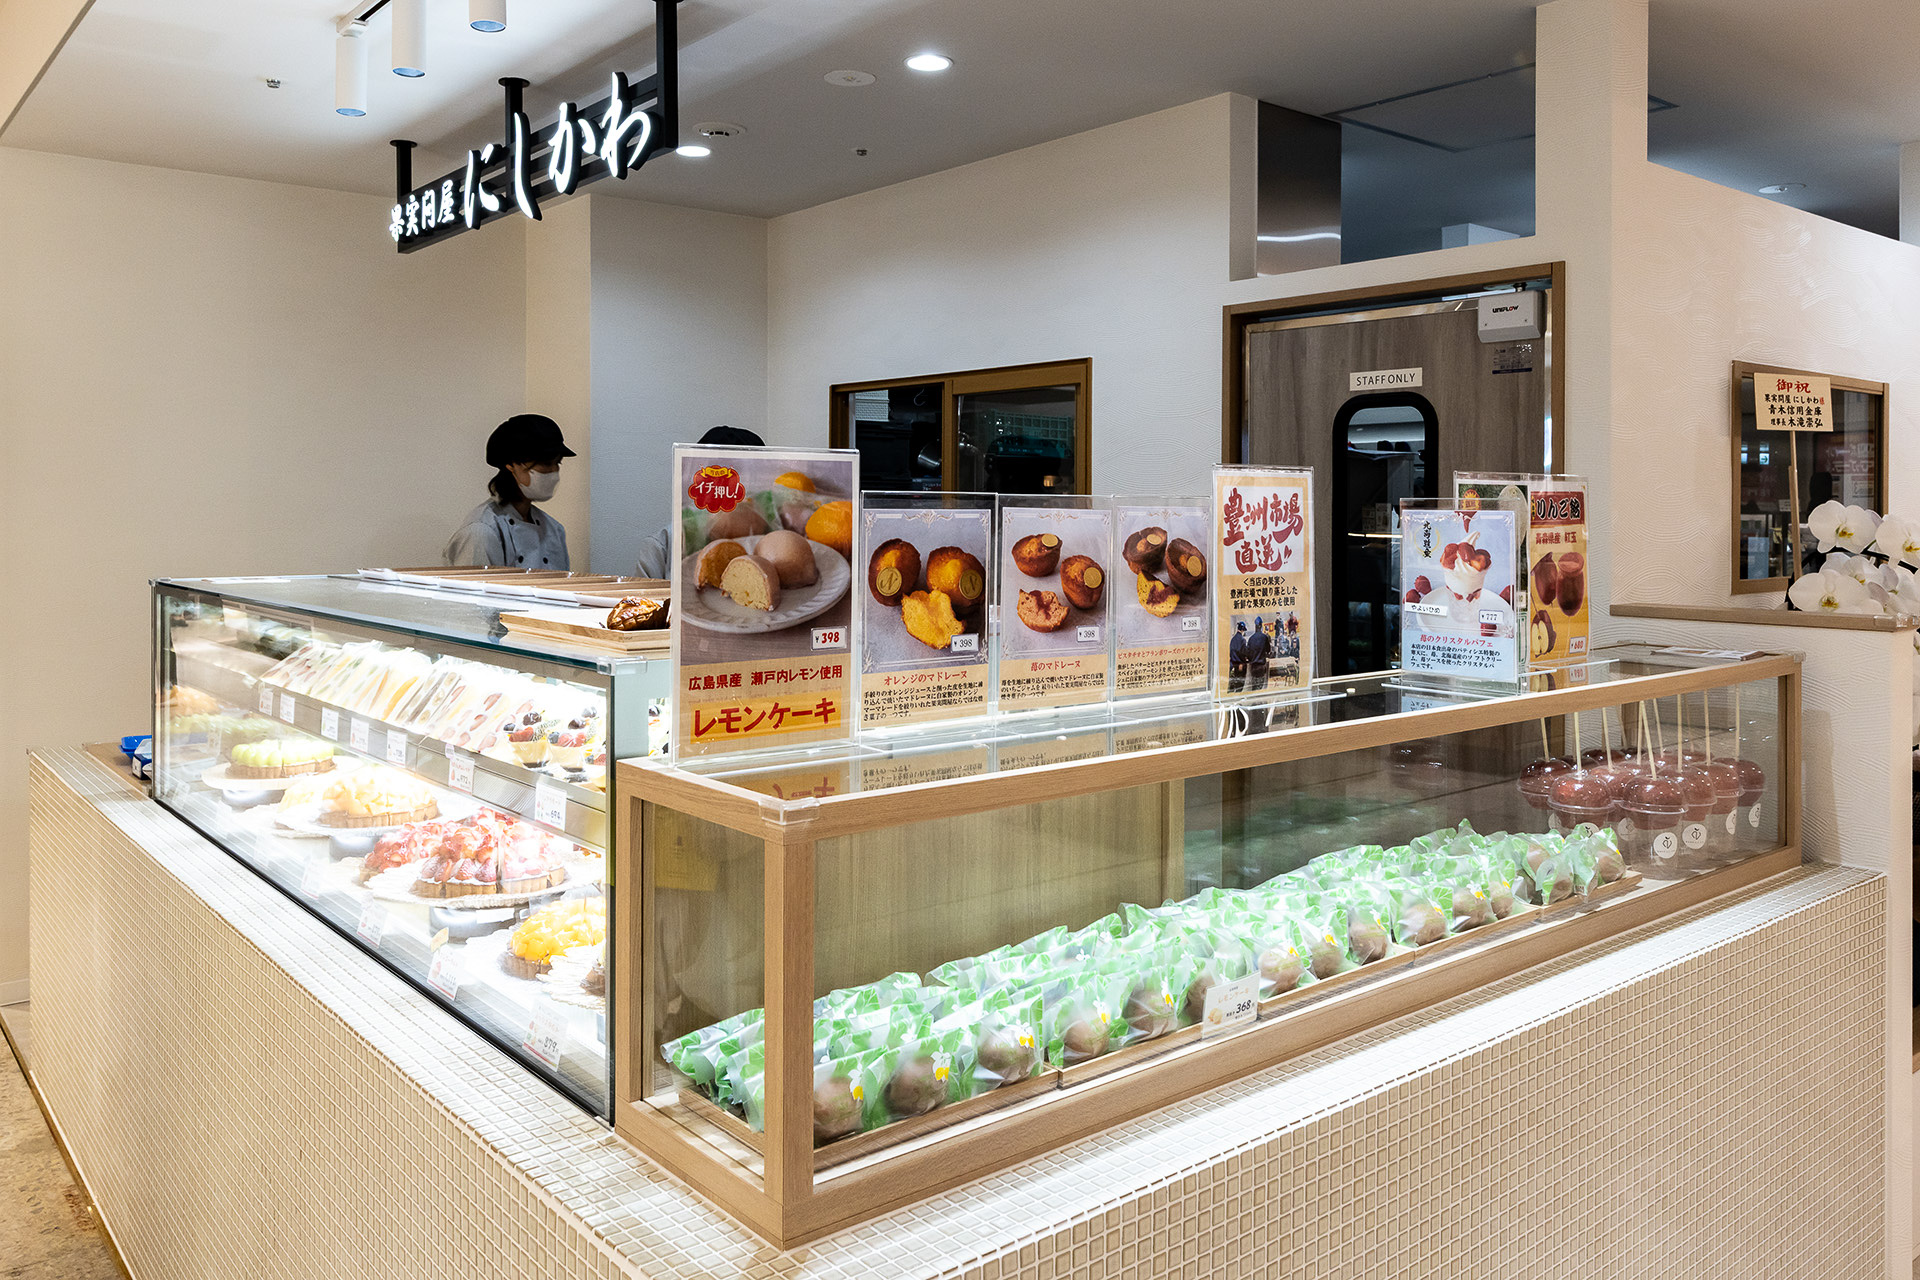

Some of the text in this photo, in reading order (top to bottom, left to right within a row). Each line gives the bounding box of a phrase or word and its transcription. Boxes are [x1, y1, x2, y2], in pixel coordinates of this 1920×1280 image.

[463, 71, 652, 229] にしかわ
[1776, 378, 1812, 393] 御祝
[1768, 404, 1823, 416] 青木信用金庫
[1536, 497, 1581, 520] りんご飴
[1411, 604, 1441, 614] やよいひめ
[1420, 633, 1494, 648] 苺のクリスタルパフェ
[1030, 660, 1081, 672] 苺のマドレーヌ
[688, 664, 843, 690] 広島県産 瀬戸内レモン使用
[884, 670, 968, 686] オレンジのマドレーヌ
[694, 697, 836, 738] レモンケーキ
[1235, 999, 1252, 1014] 368
